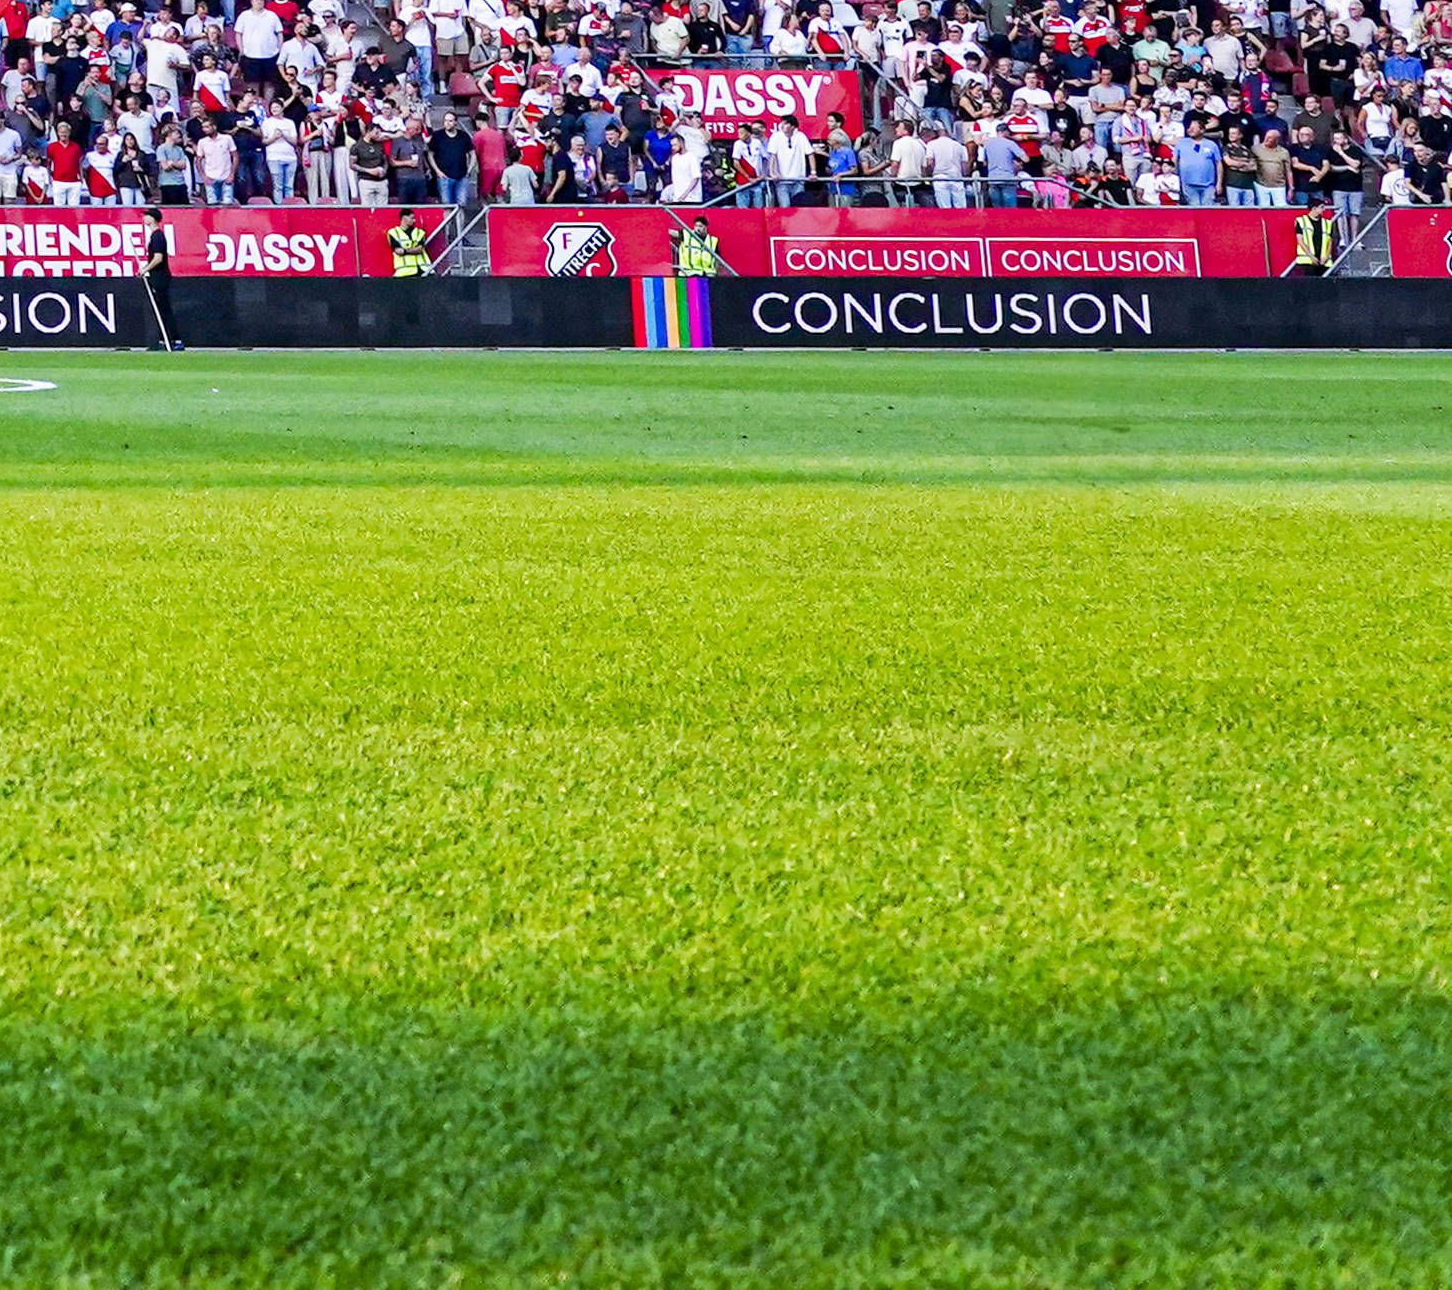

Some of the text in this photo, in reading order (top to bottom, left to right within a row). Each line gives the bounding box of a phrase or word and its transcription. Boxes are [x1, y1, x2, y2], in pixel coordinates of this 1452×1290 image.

[674, 73, 822, 117] DASSY
[705, 122, 734, 134] FITS
[205, 233, 342, 272] DASSY
[562, 232, 573, 250] F
[786, 248, 971, 271] CONCLUSION
[1000, 249, 1185, 272] CONCLUSION
[752, 291, 1153, 334] CONCLUSION
